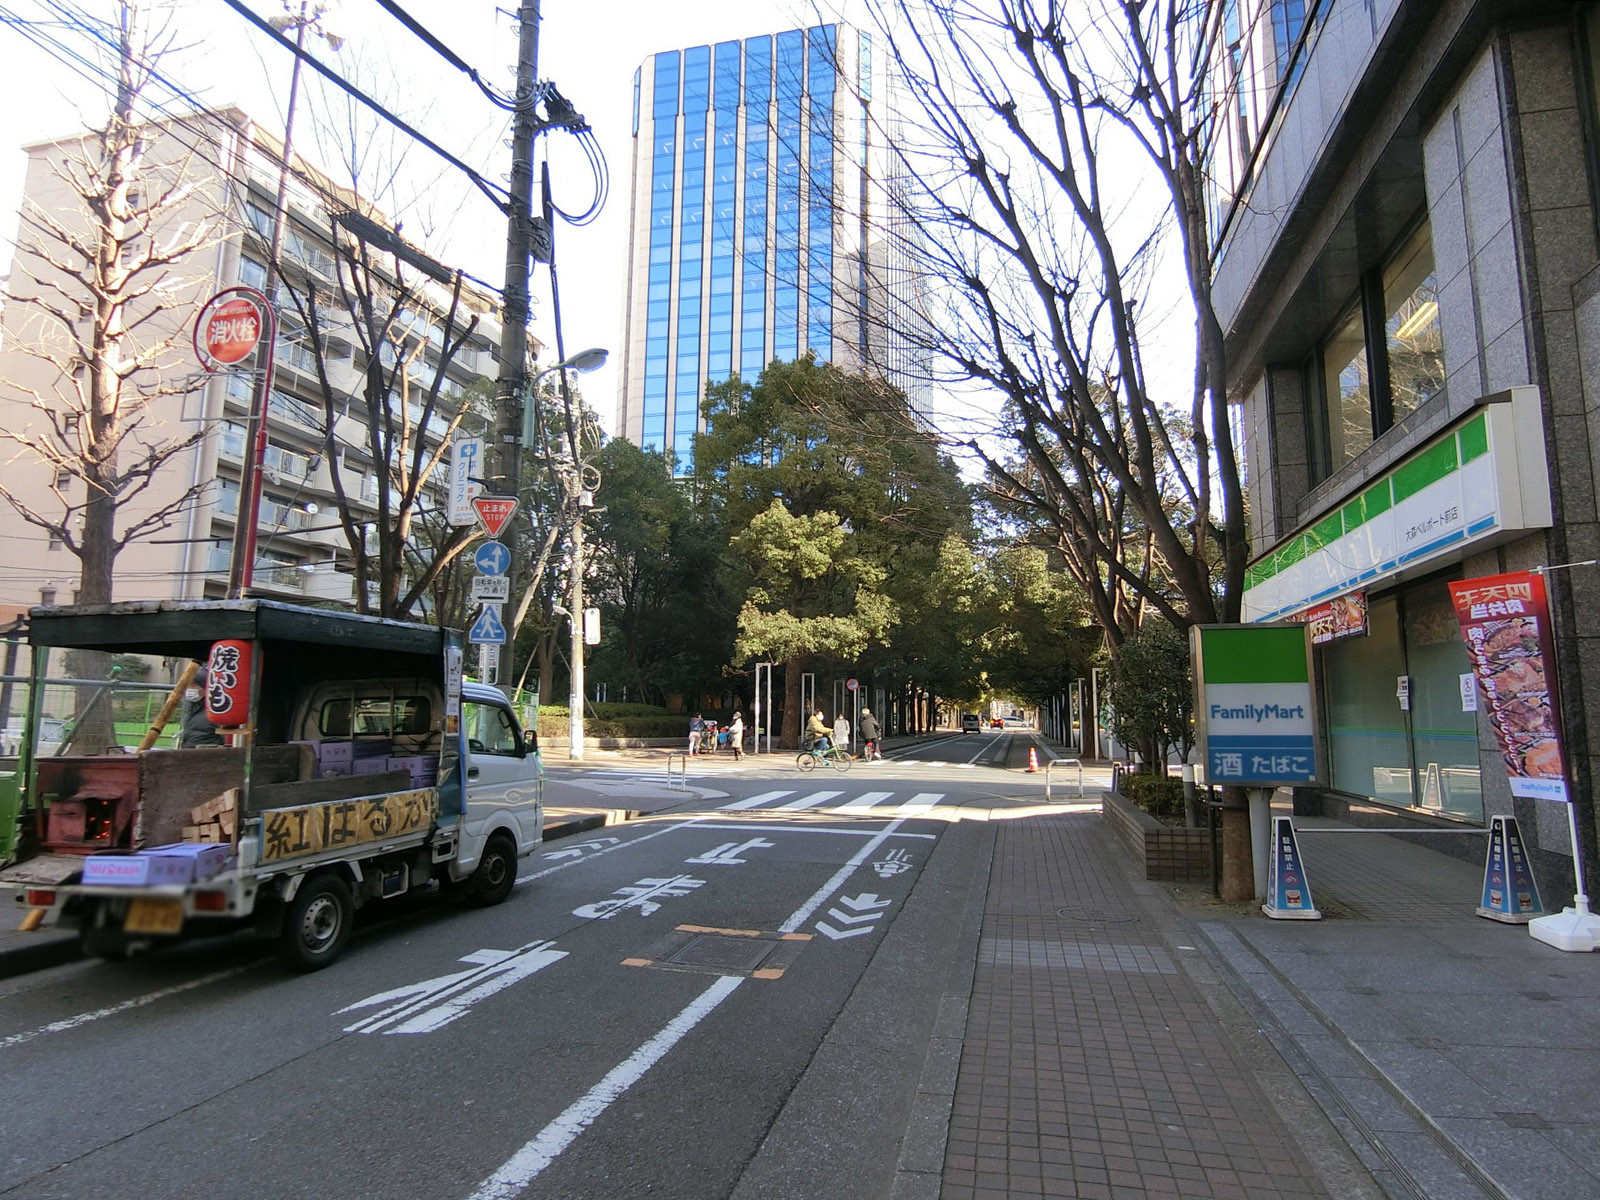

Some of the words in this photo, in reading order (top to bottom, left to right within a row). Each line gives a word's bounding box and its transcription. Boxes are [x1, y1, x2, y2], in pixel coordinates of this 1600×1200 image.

[209, 317, 257, 345] 消火栓
[456, 461, 466, 502] クリニック
[482, 504, 507, 513] 止まれ
[486, 513, 505, 521] STOP
[1406, 506, 1458, 542] 大森ベルポート前店
[475, 586, 507, 594] 一方通行
[208, 644, 240, 714] 焼いも
[1210, 704, 1304, 722] FamilyMart
[1214, 752, 1243, 776] 酒
[1251, 755, 1310, 774] たばこ
[265, 793, 430, 859] 紅はるか
[1282, 836, 1294, 870] 駐輪禁止
[1493, 836, 1502, 871] 駐輪禁止
[1510, 836, 1523, 872] 駐輪禁止
